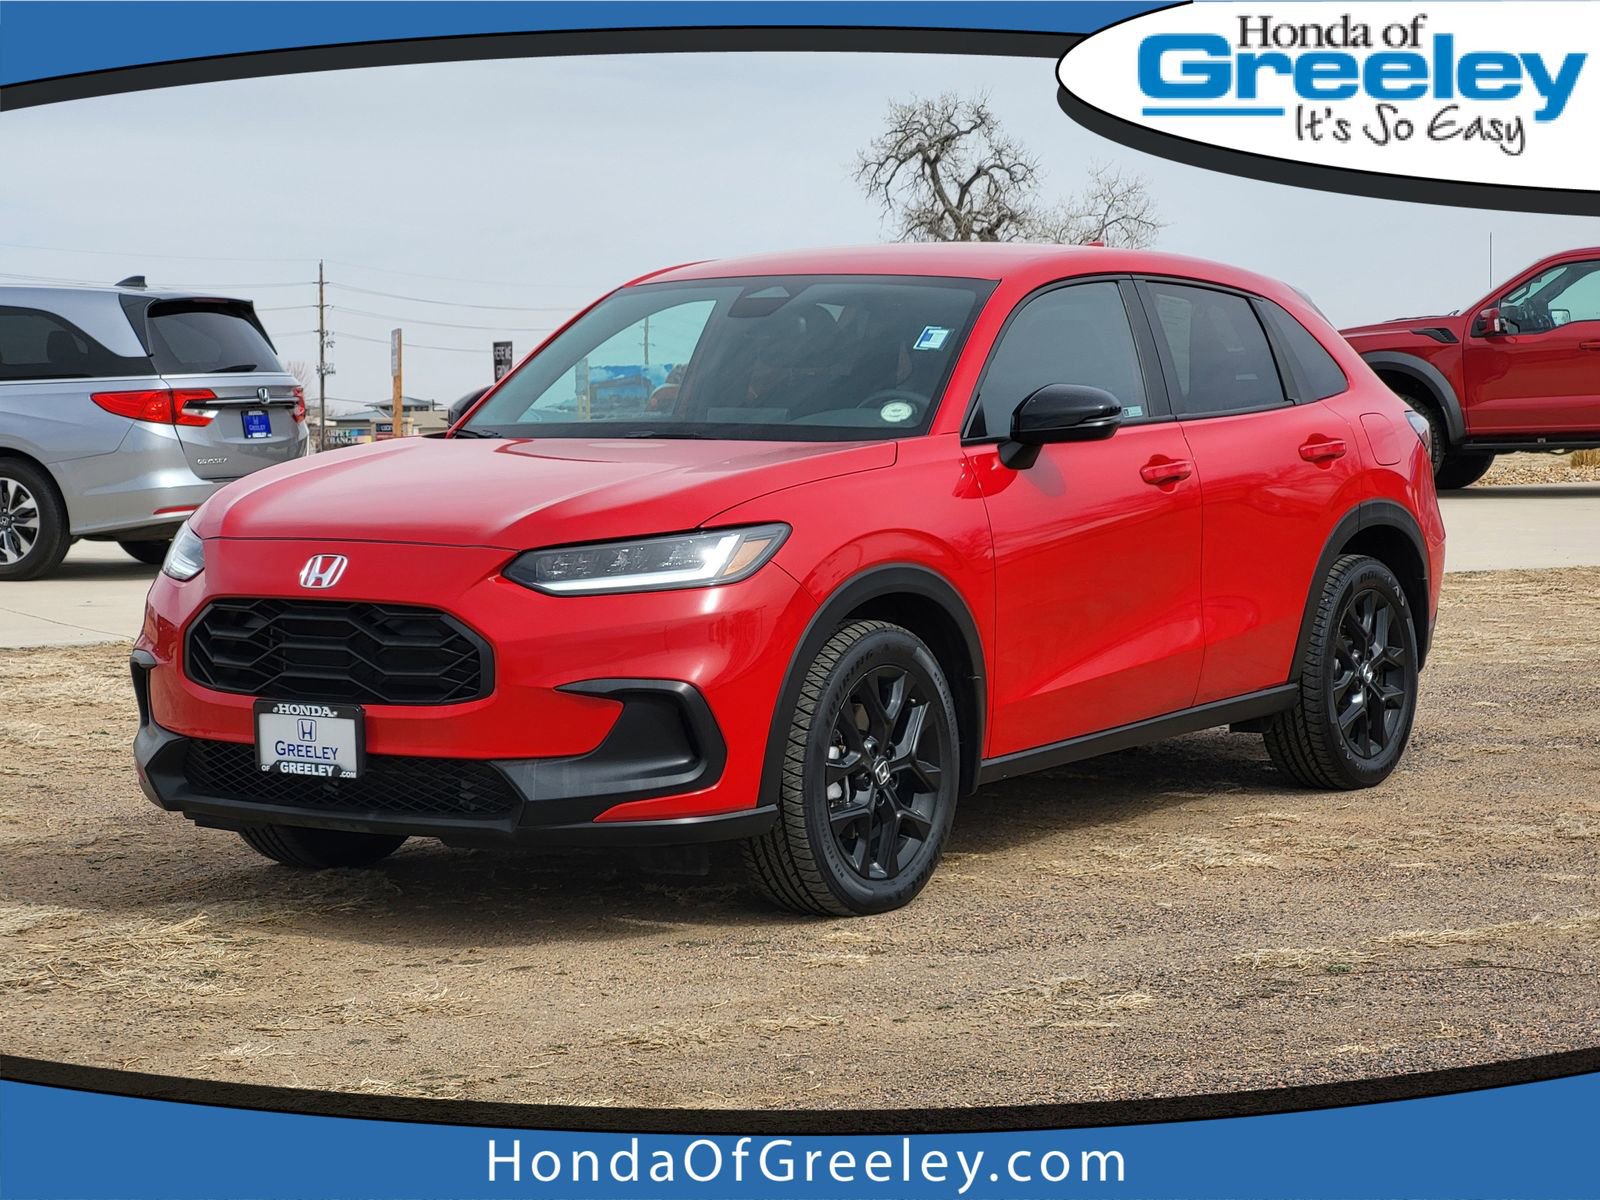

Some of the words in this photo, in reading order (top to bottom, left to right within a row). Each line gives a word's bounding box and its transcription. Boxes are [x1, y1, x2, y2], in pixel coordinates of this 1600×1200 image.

[276, 703, 334, 717] HONDA
[275, 740, 338, 760] GREELEY
[280, 762, 334, 777] GREELEY
